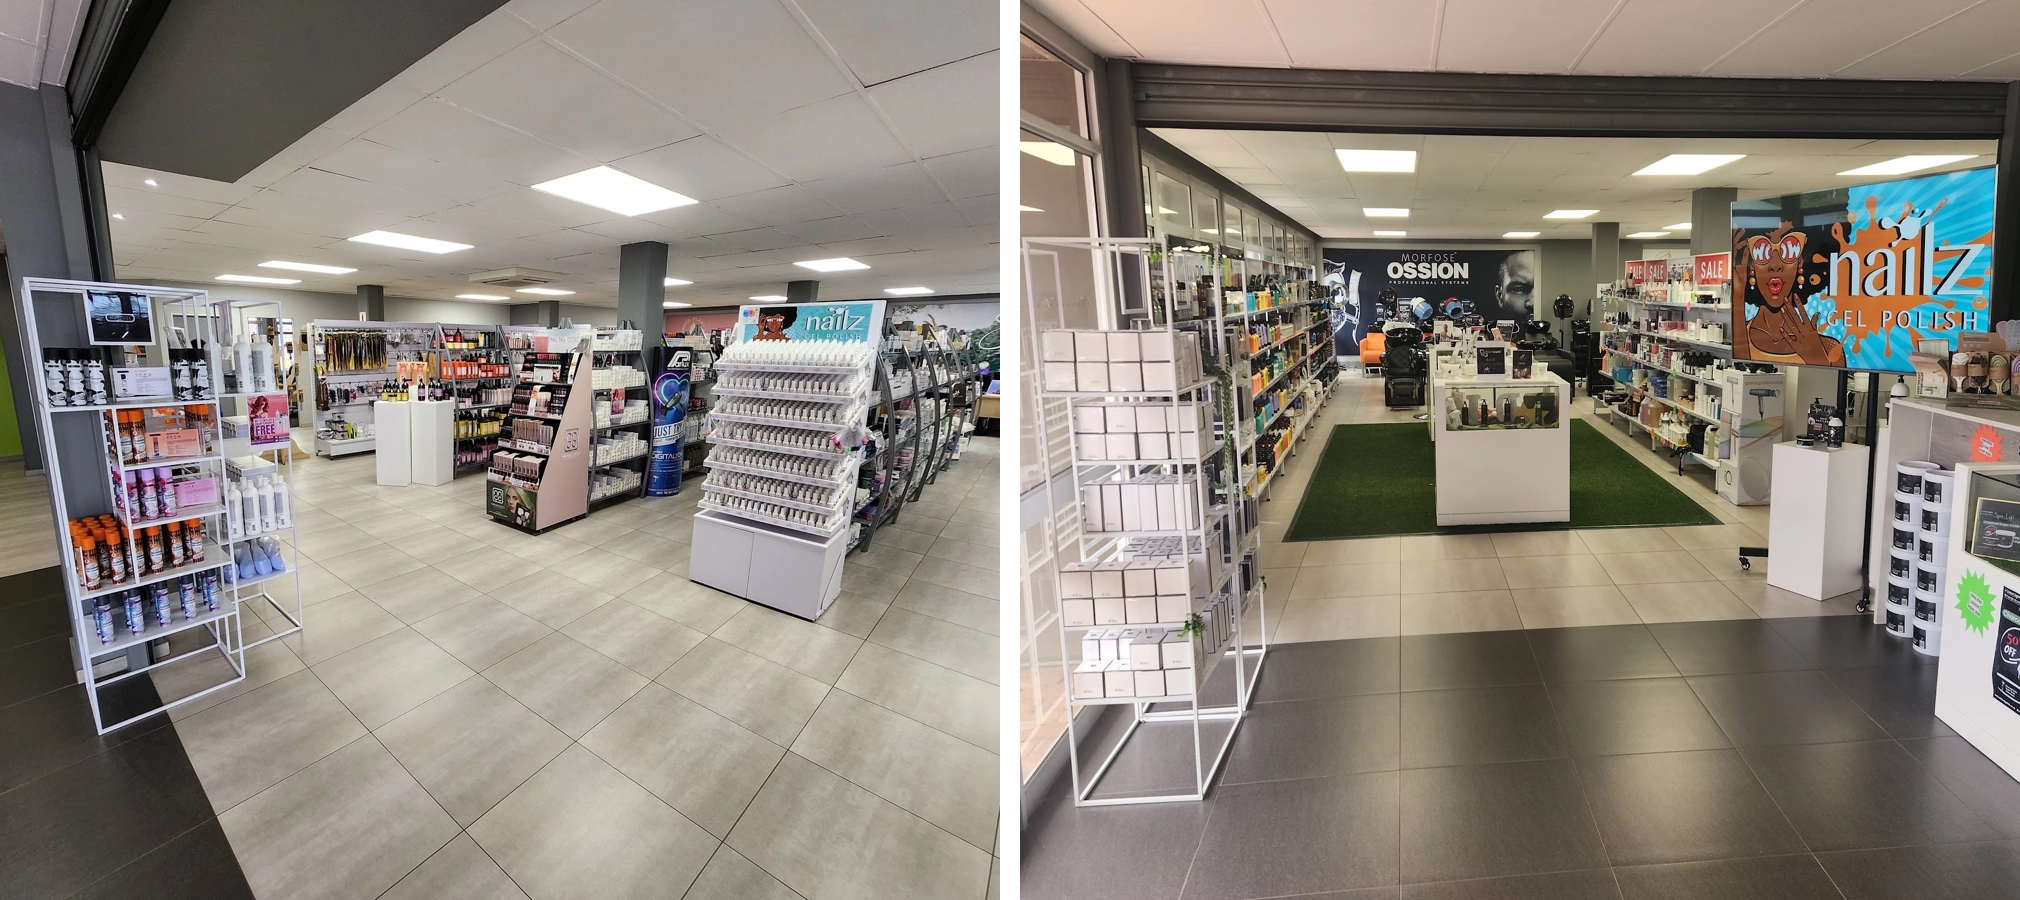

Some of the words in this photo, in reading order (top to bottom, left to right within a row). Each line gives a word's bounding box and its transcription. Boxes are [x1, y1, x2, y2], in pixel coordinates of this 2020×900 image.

[1401, 253, 1455, 262] MORFOSE
[1827, 209, 1985, 297] nailz
[1387, 262, 1469, 279] OSSION
[1649, 264, 1664, 279] SALE
[1701, 260, 1723, 279] SALE
[804, 306, 865, 331] nailz
[1827, 310, 1866, 328] GEL
[1881, 310, 1978, 331] POLISH
[667, 351, 690, 368] Parlux
[255, 424, 276, 436] FREE
[654, 425, 672, 438] JUST
[2007, 632, 2020, 647] 50
[2003, 644, 2017, 658] OFF
